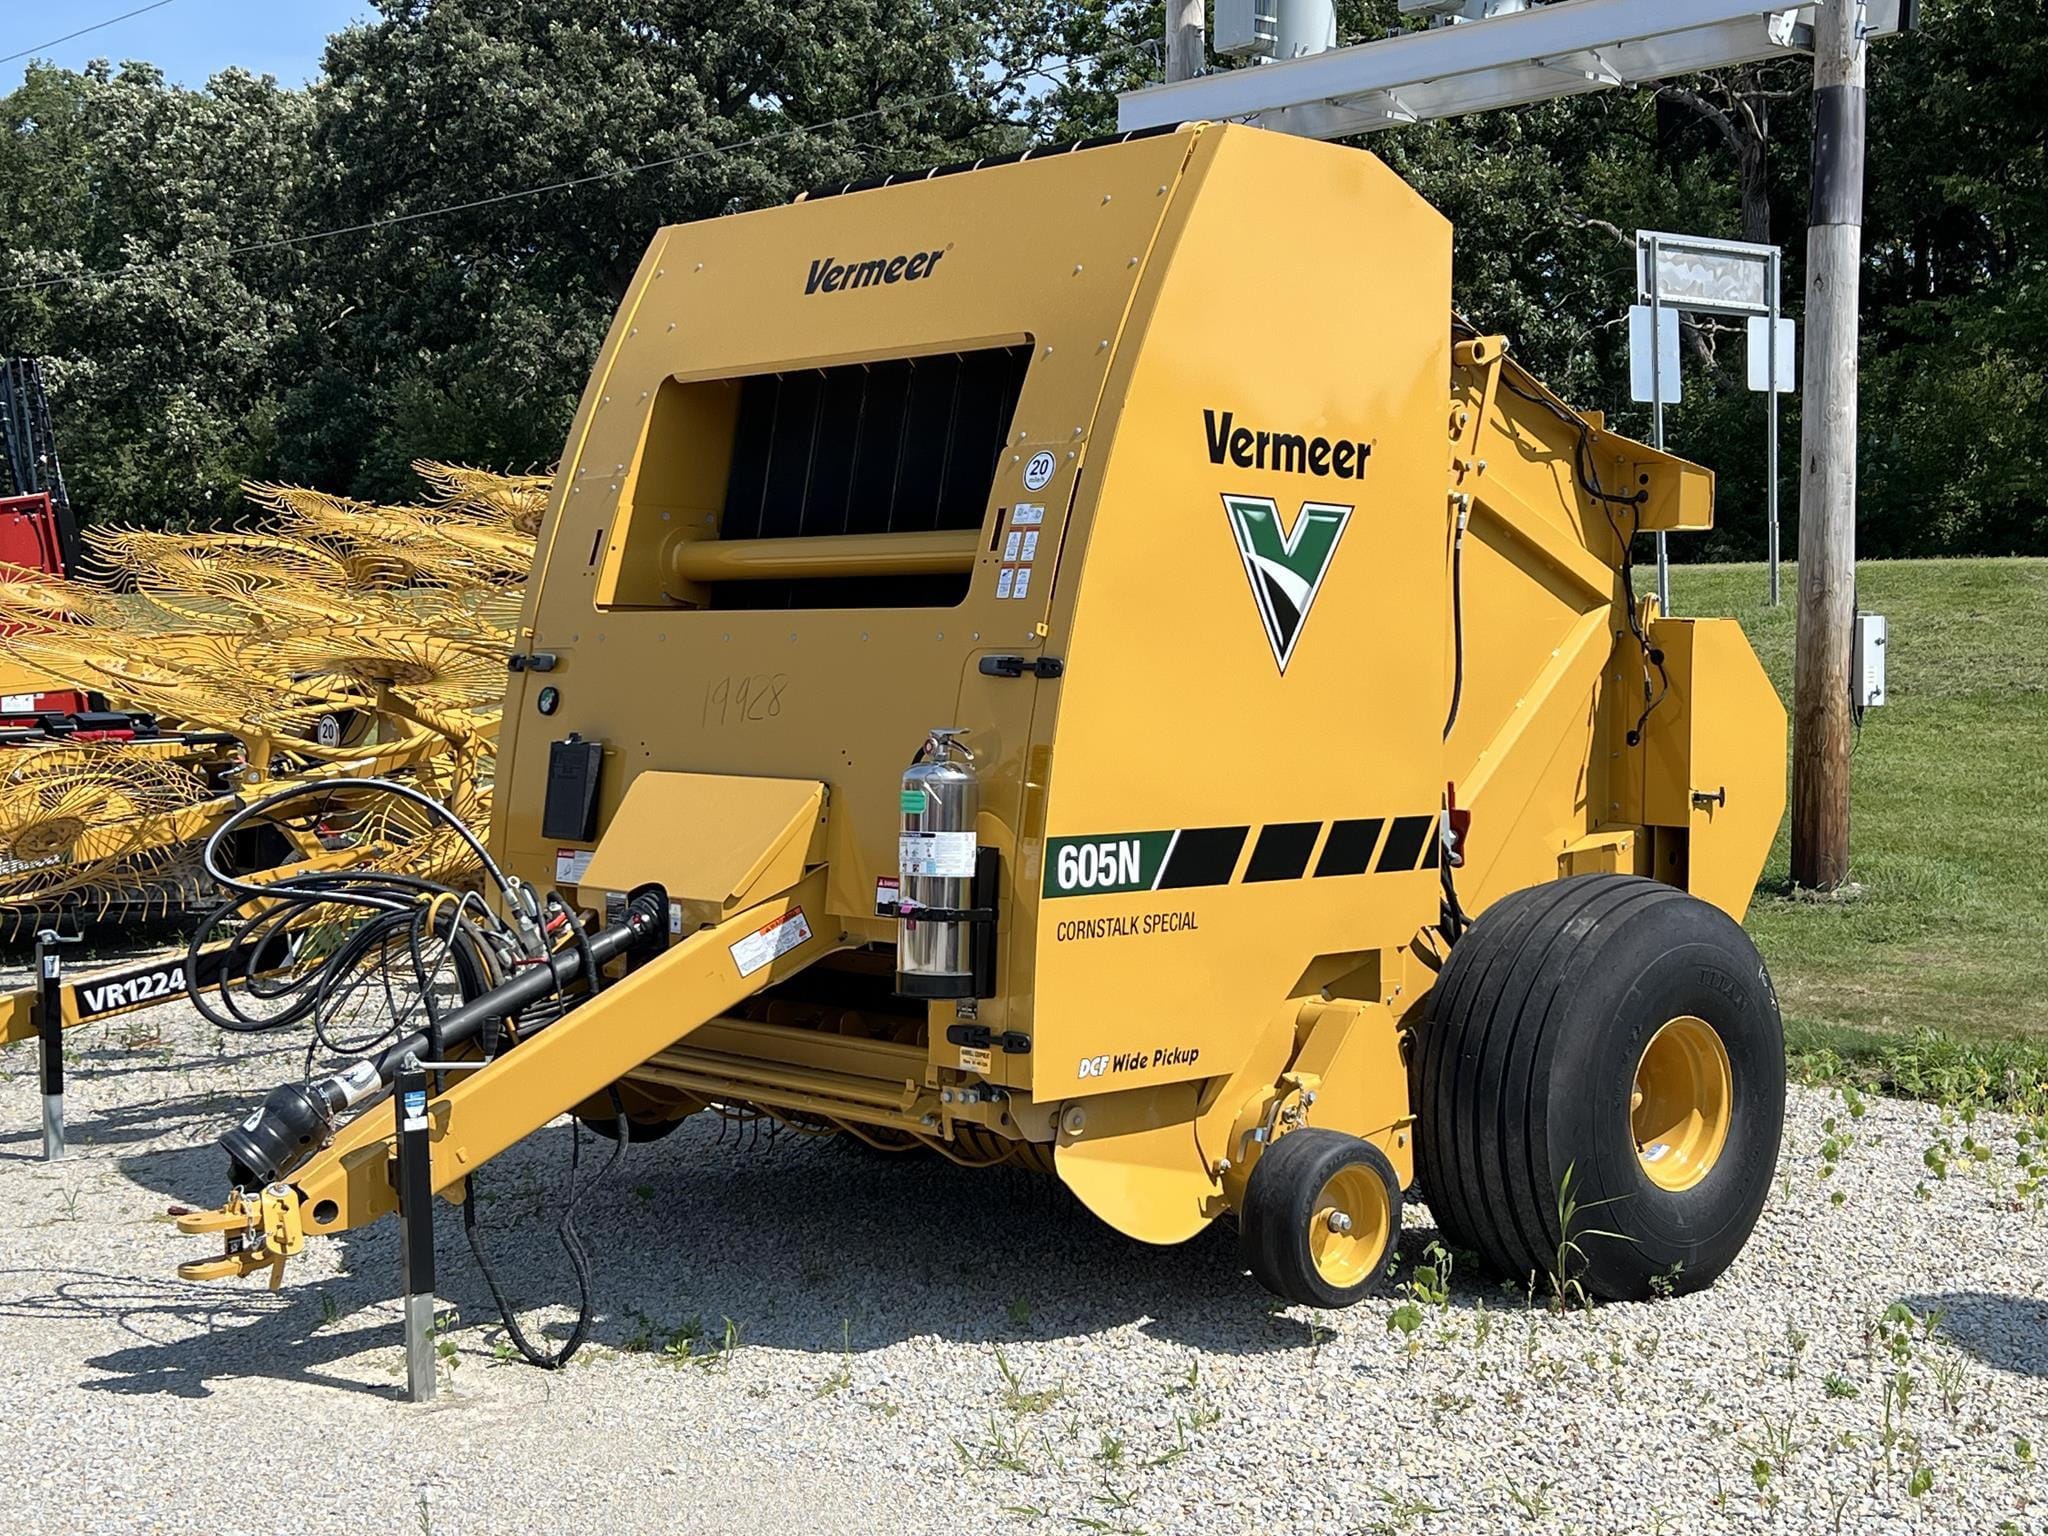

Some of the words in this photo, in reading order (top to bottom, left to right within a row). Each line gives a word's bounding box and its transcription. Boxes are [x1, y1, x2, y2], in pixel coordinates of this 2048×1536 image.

[804, 250, 945, 295] Vermeer
[1203, 409, 1371, 480] Vermeer
[1030, 459, 1049, 476] 20
[702, 672, 789, 728] 19928
[322, 723, 334, 740] 20
[1057, 840, 1141, 890] 605N
[1057, 916, 1140, 942] CORNSTALK
[1143, 911, 1199, 934] SPECIAL
[83, 967, 186, 1012] VR1224
[1078, 1055, 1110, 1079] DCF
[1112, 1051, 1149, 1073] Wide
[1152, 1046, 1199, 1068] Pickup
